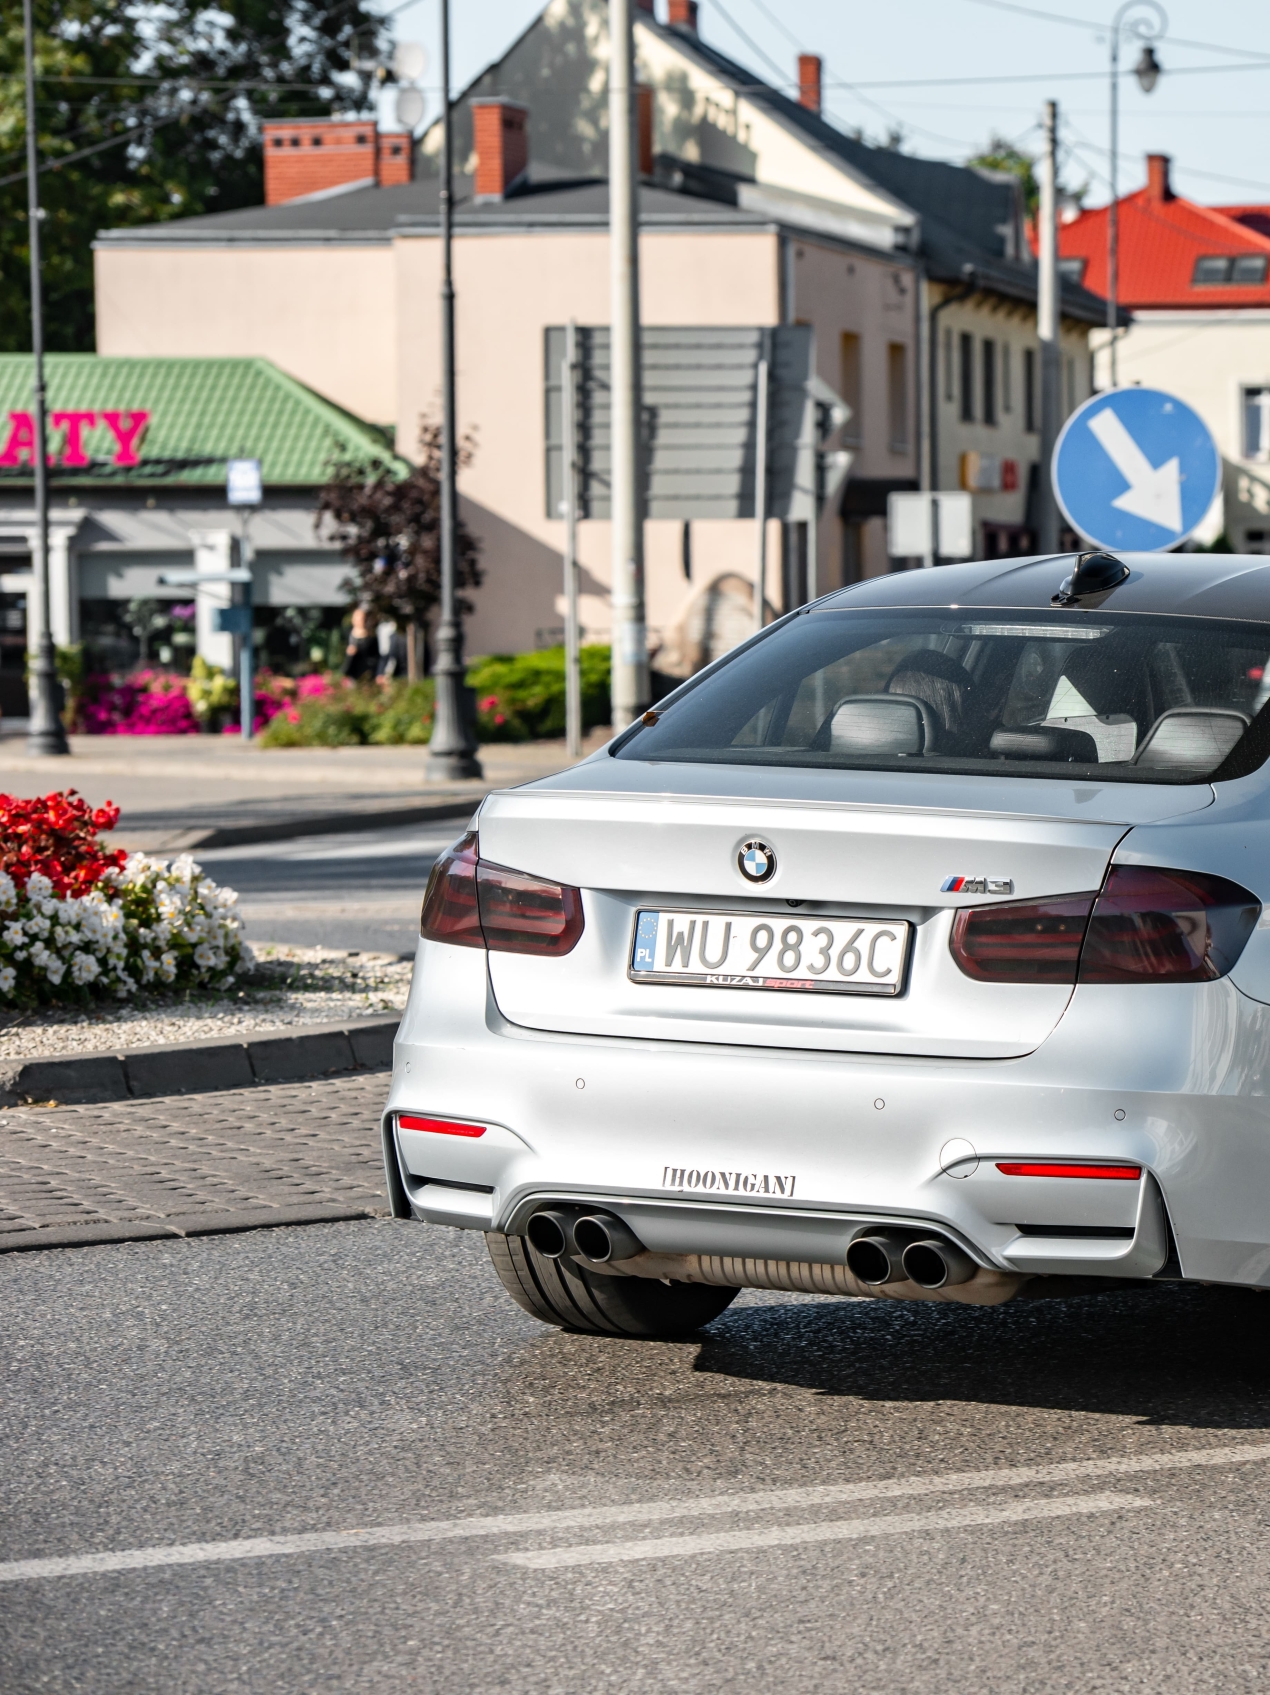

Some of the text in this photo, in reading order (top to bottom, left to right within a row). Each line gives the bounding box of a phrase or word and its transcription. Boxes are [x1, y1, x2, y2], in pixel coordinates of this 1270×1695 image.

[0, 410, 151, 468] ATY
[740, 841, 772, 857] BMW
[959, 876, 1012, 895] M3
[637, 948, 653, 963] PL
[664, 918, 898, 979] WU 9836C
[705, 974, 815, 988] KUZAJ sport
